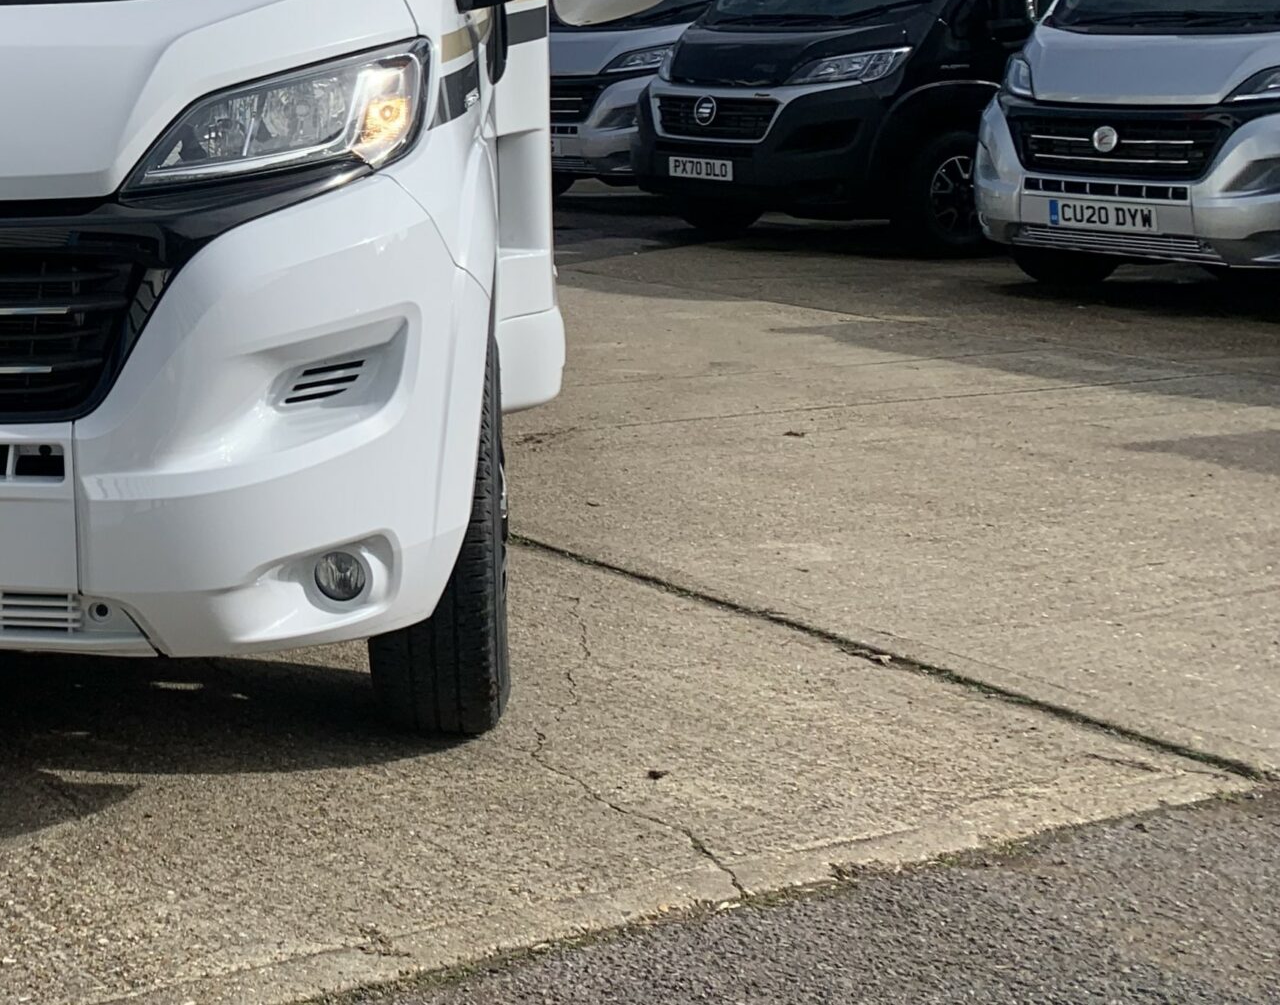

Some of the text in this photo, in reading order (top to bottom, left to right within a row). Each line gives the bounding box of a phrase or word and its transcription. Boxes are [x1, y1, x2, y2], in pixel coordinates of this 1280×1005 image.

[673, 158, 728, 178] PX70 DLO
[1061, 203, 1152, 229] CU20 DYW
